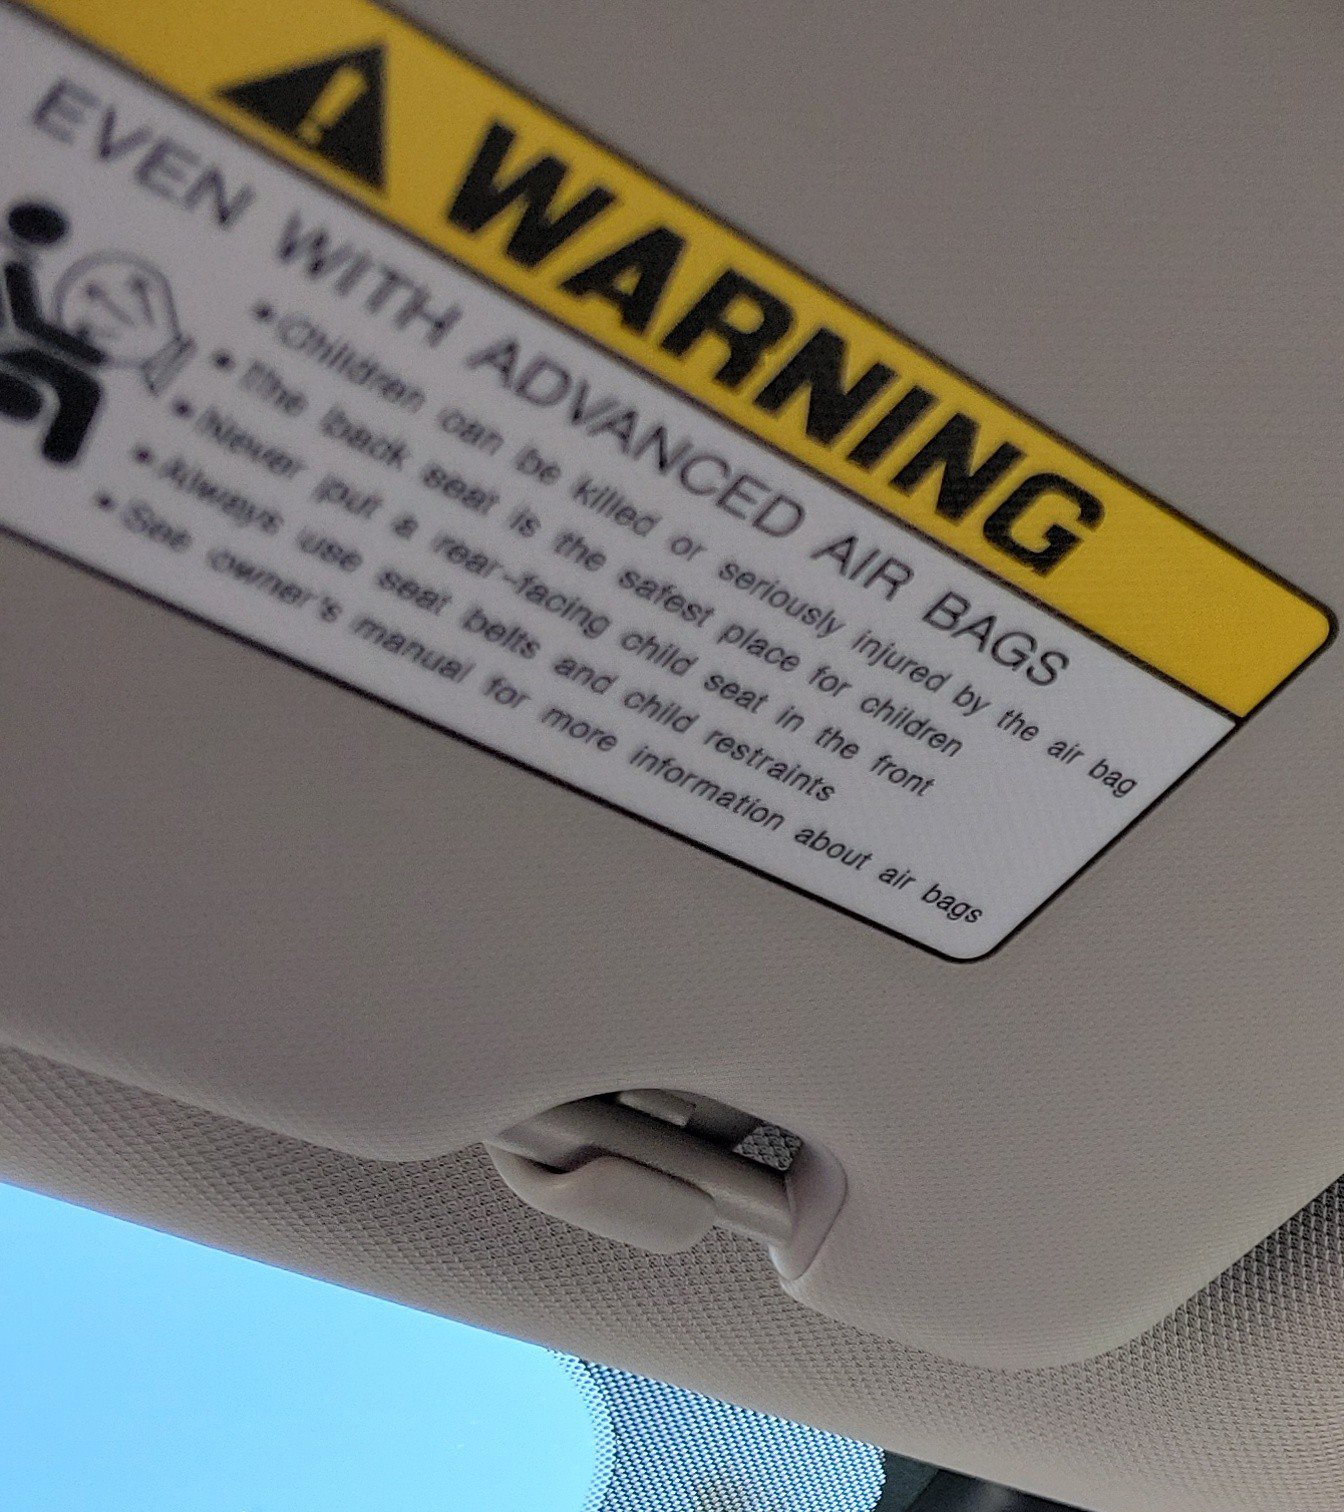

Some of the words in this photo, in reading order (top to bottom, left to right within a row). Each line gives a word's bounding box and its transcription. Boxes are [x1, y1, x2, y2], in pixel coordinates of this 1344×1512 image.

[30, 77, 256, 232] EVEN
[274, 212, 463, 349] WITH
[464, 336, 807, 539] ADVANCED
[807, 532, 916, 603] AIR
[919, 588, 1071, 688] BAGS
[445, 122, 1106, 579] WARNING
[205, 547, 344, 624] owner's
[348, 614, 476, 684] manual
[481, 673, 532, 710] for
[538, 703, 619, 753] more
[626, 742, 786, 832] information
[791, 826, 875, 872] about
[875, 865, 918, 891] air
[918, 880, 984, 924] bags
[295, 528, 364, 573] use
[374, 566, 453, 616] seat
[459, 604, 542, 660] belts
[550, 654, 620, 696] and
[620, 689, 701, 735] child
[701, 727, 837, 803] restraints
[311, 473, 384, 520] put
[388, 512, 420, 541] a
[430, 533, 613, 640] rear-facing
[617, 629, 700, 678] child
[701, 671, 770, 715] seat
[772, 702, 806, 734] in
[812, 724, 861, 761] the
[867, 751, 937, 798] front
[318, 405, 409, 471] back
[418, 462, 501, 516] seat
[506, 505, 542, 539] is
[551, 529, 608, 573] the
[615, 567, 716, 629] safest
[714, 621, 802, 673] place
[806, 662, 854, 698] for
[857, 694, 964, 759] children
[436, 407, 505, 456] can
[512, 443, 562, 486] be
[569, 474, 663, 538] killed
[666, 532, 709, 563] or
[715, 558, 847, 640] seriously
[849, 627, 954, 694] injured
[949, 681, 993, 718] by
[994, 707, 1041, 743] the
[1044, 738, 1086, 766] air
[1085, 756, 1139, 800] bag
